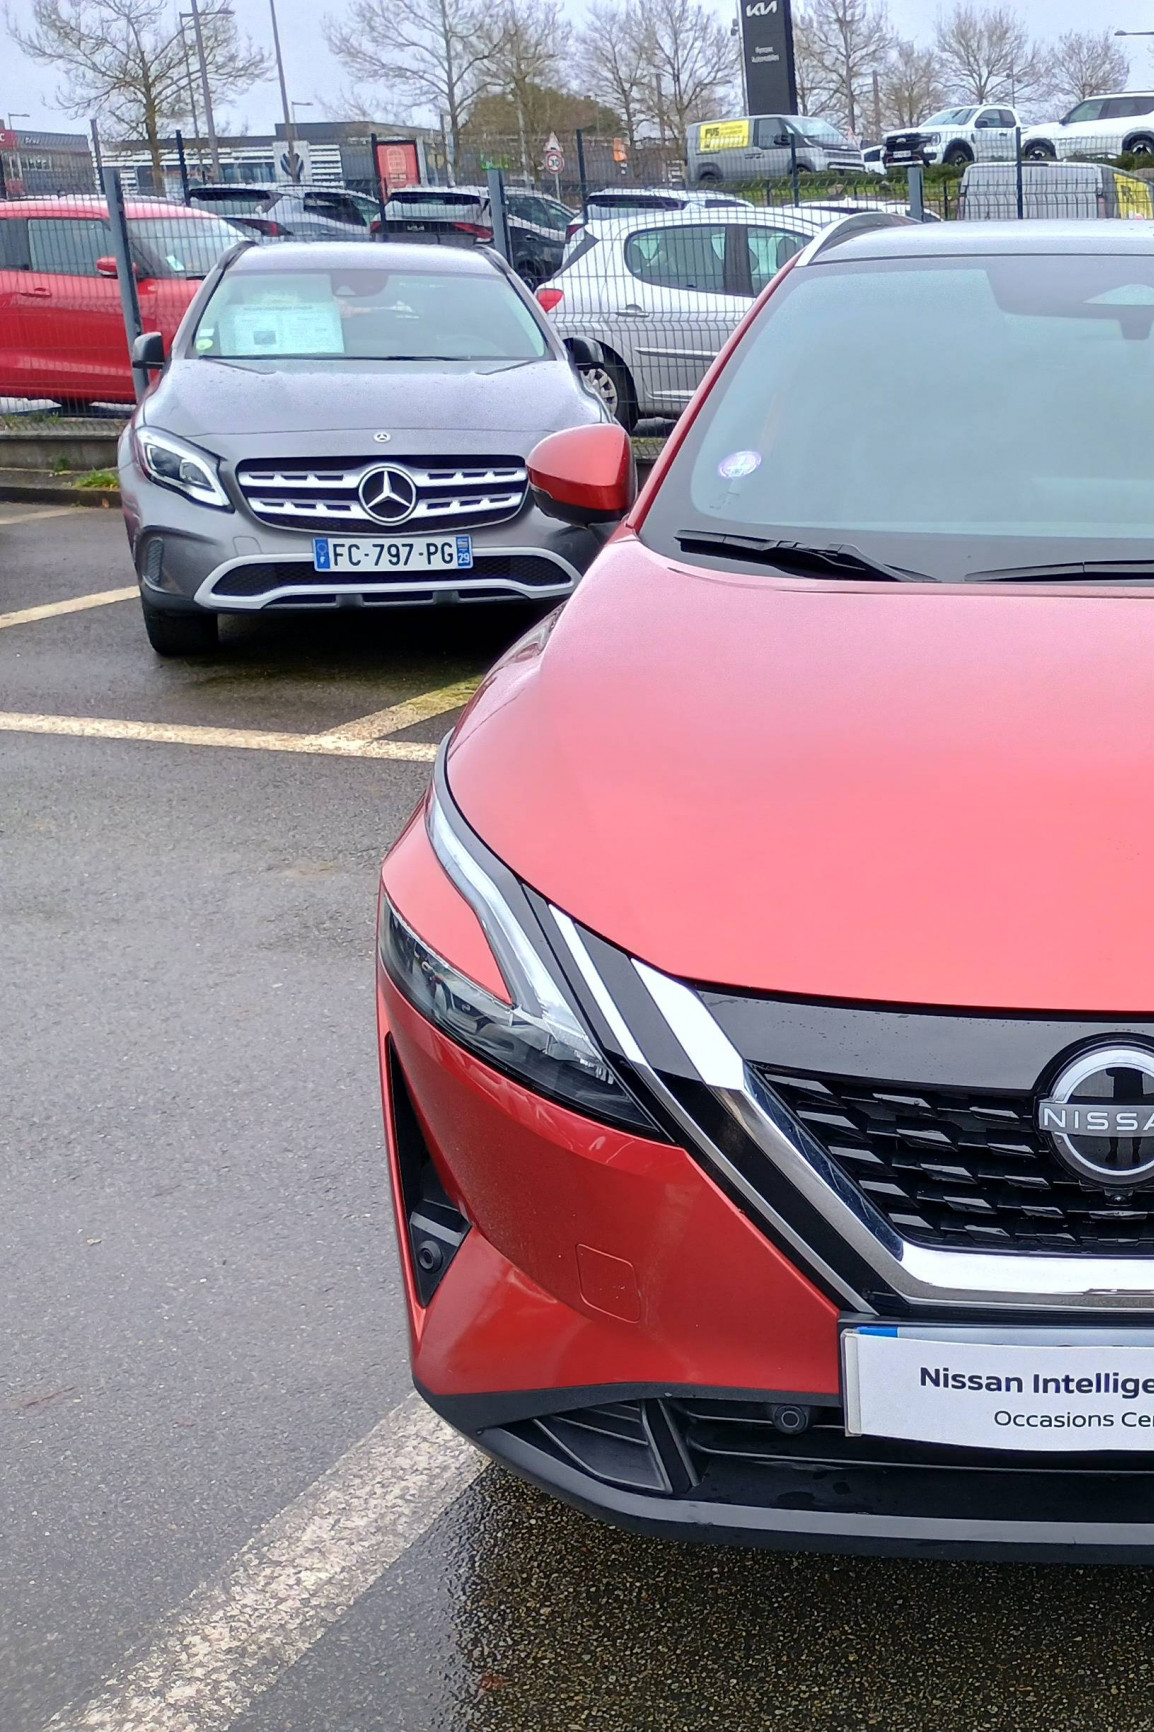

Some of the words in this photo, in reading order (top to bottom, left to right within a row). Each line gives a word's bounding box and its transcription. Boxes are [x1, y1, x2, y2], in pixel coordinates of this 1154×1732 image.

[333, 543, 453, 566] FC-797-PG
[458, 552, 470, 564] 29
[920, 1367, 1023, 1393] Nissan
[994, 1410, 1115, 1428] Occasions
